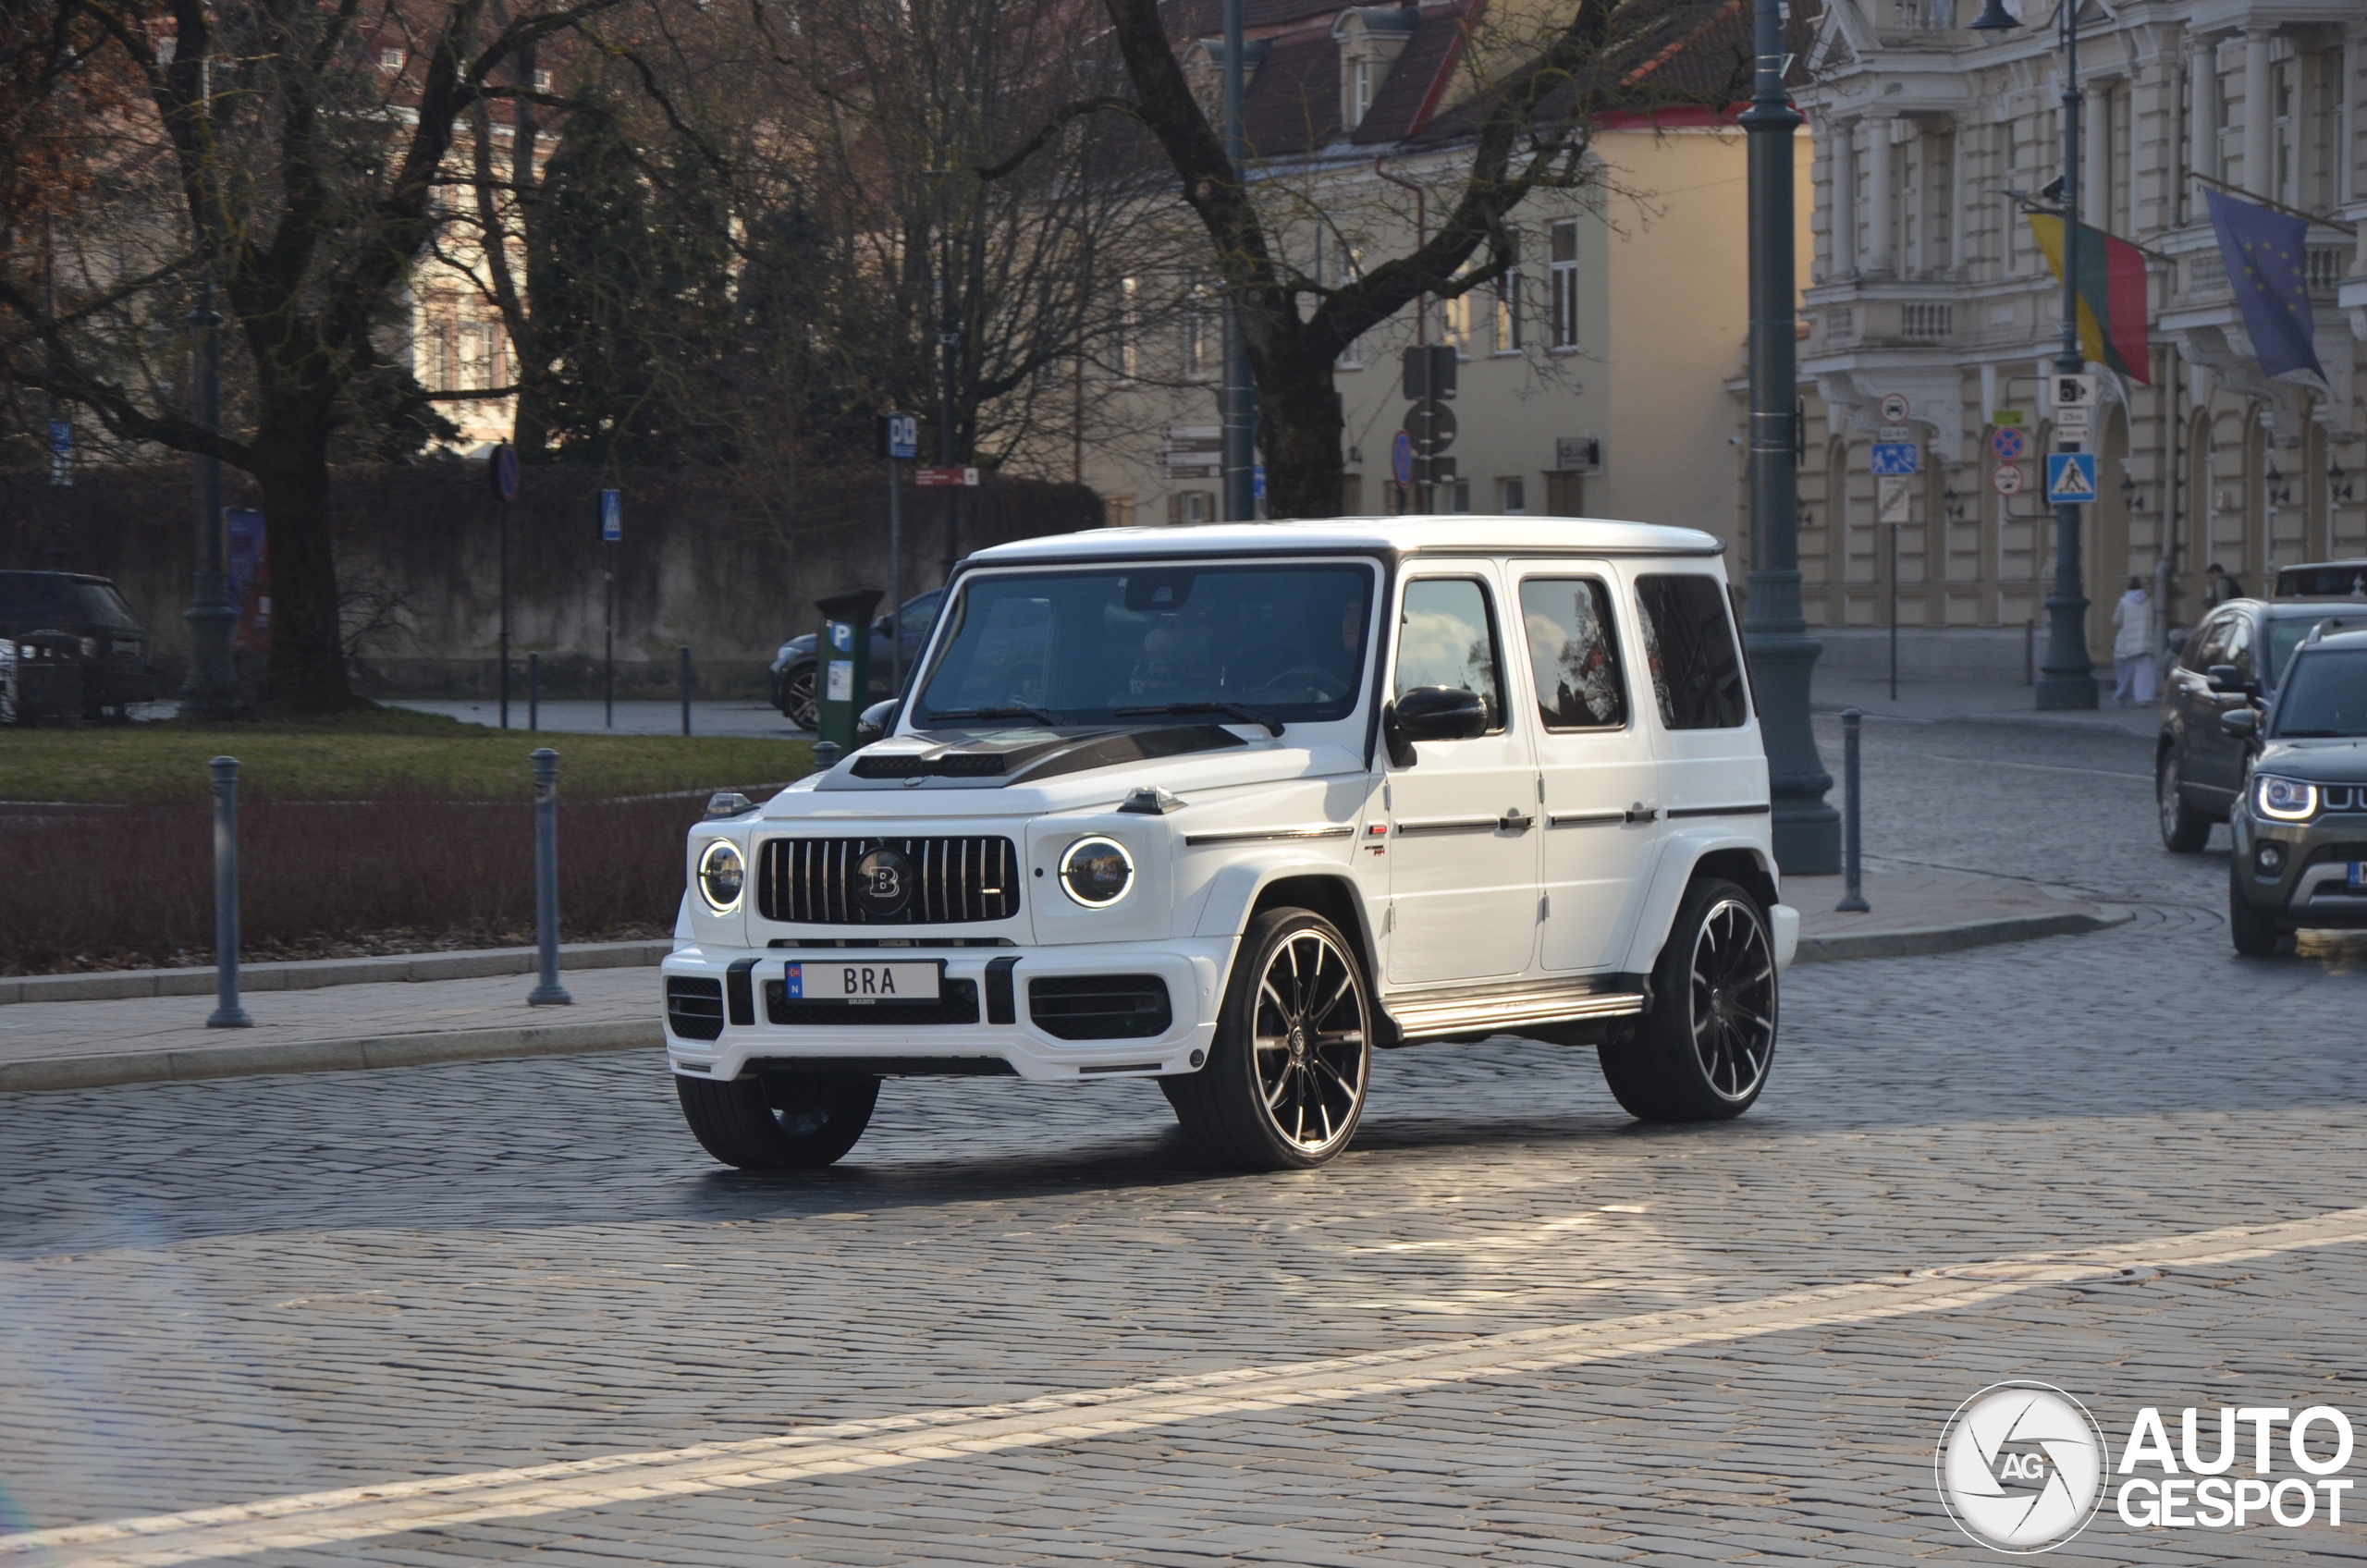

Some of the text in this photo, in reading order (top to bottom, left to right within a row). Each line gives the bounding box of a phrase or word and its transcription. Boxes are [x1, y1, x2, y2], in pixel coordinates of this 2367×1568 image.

[834, 625, 851, 646] P
[869, 866, 900, 897] B
[843, 968, 896, 994] BRA
